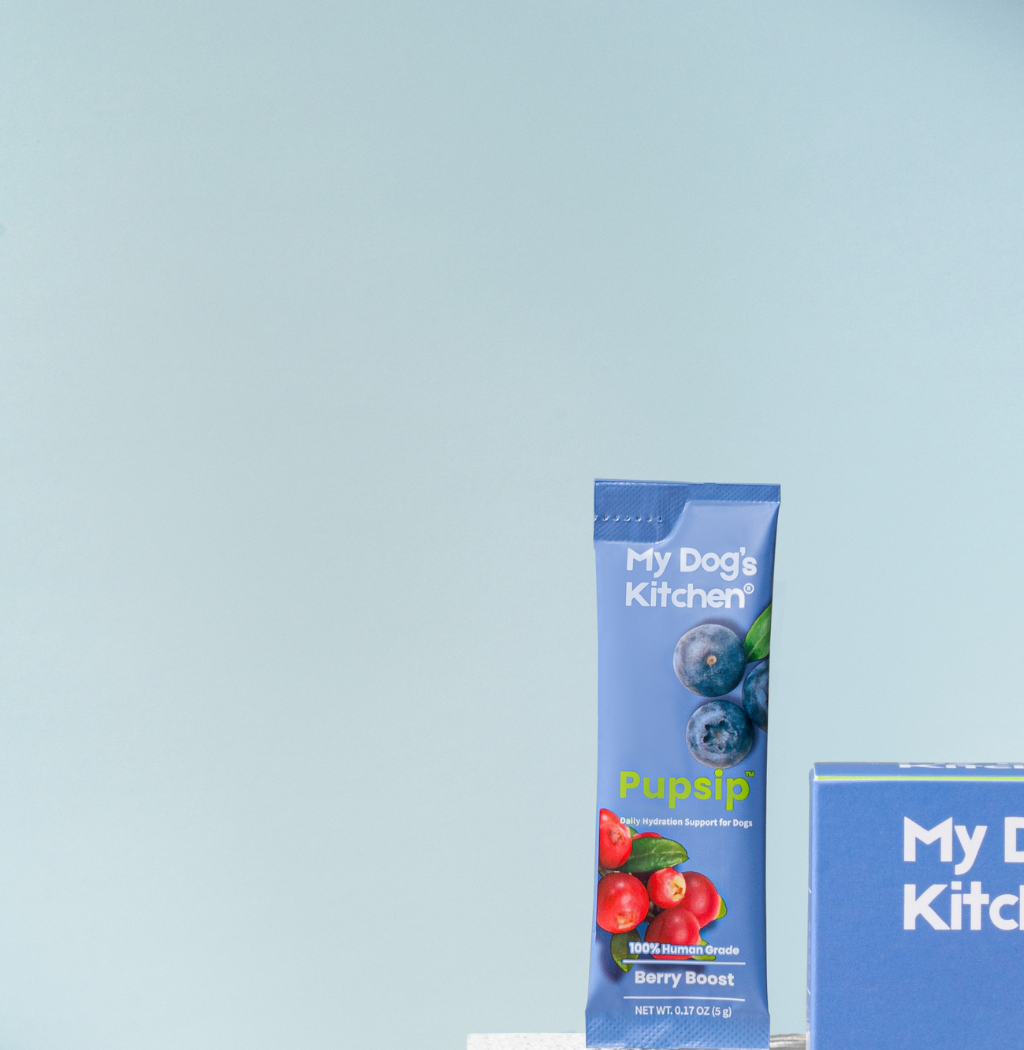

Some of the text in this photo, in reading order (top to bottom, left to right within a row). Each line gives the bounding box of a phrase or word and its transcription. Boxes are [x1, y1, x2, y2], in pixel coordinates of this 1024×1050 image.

[626, 547, 757, 581] My Dog's
[620, 817, 753, 829] Daily Hydration Support for Dogs
[903, 816, 988, 875] My
[629, 942, 739, 955] 100% Human Grade
[635, 970, 735, 988] Berry Boost
[635, 1005, 654, 1015] NET
[656, 1005, 673, 1015] WT.
[674, 1006, 694, 1016] 0.17
[696, 1006, 710, 1016] OZ
